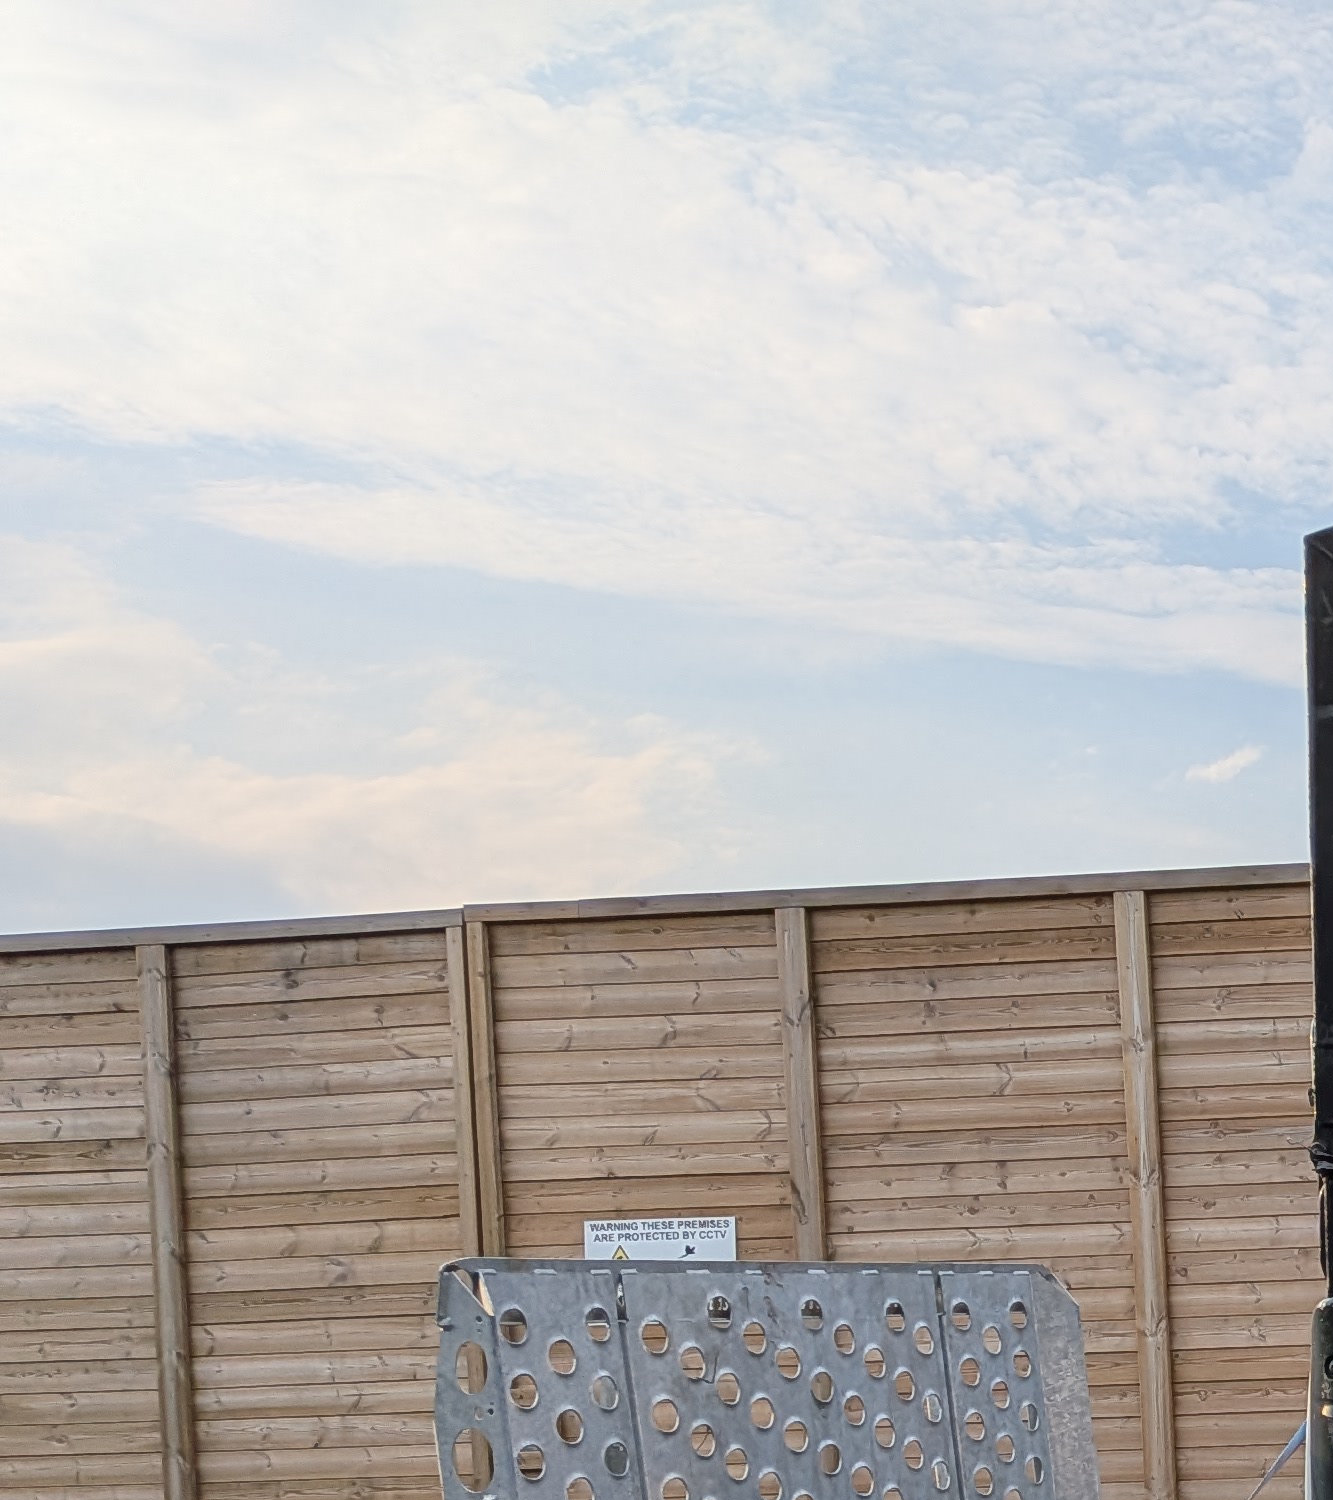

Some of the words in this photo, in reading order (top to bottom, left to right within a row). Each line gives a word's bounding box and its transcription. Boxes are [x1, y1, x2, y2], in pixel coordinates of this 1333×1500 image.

[590, 1221, 638, 1232] WARNING
[640, 1220, 675, 1231] THESE
[677, 1219, 730, 1230] PREMISES
[593, 1233, 615, 1243] ARE
[617, 1231, 679, 1242] PROTECTED
[682, 1230, 696, 1240] BY
[699, 1230, 727, 1239] CCTV
